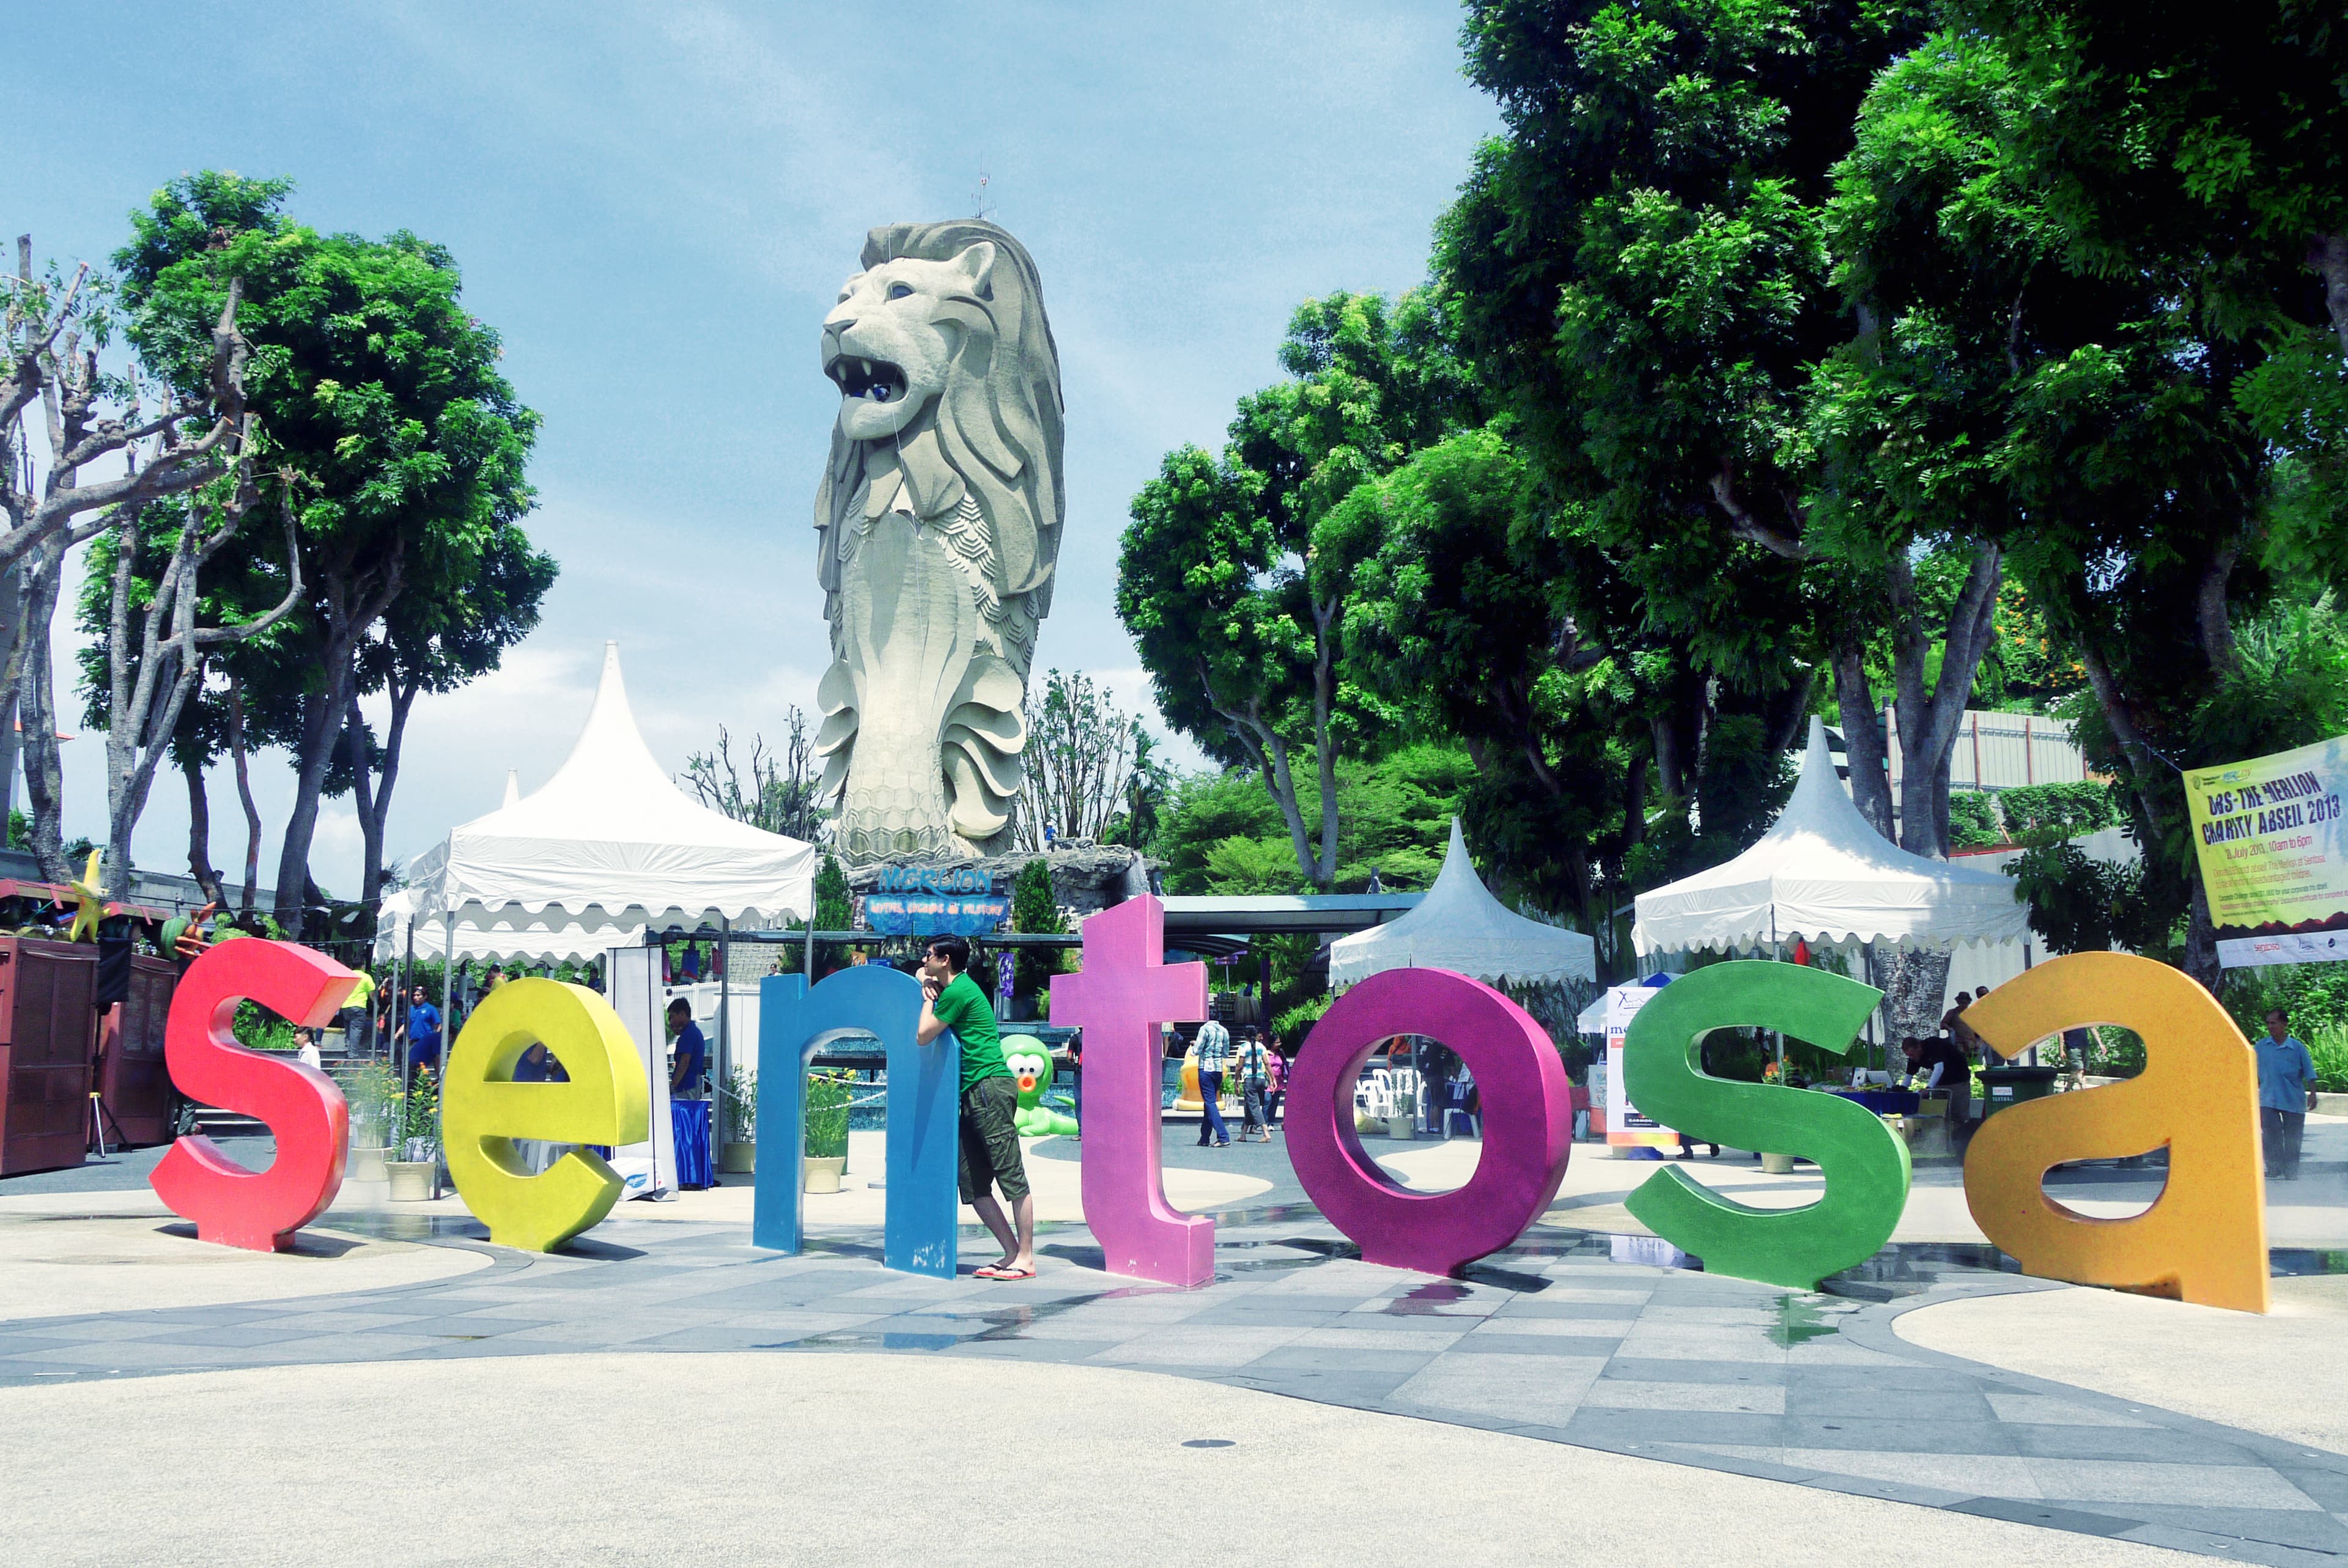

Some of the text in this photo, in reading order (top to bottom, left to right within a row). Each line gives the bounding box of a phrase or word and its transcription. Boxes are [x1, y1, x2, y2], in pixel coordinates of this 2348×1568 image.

[2261, 771, 2322, 803] MERLION
[2202, 794, 2341, 845] CHARITY ABSEIL 2013
[2269, 840, 2288, 853] 10am
[2289, 837, 2297, 848] to
[2297, 835, 2313, 849] 6pm
[878, 866, 994, 900] MERLION
[148, 893, 2271, 1314] sentosa
